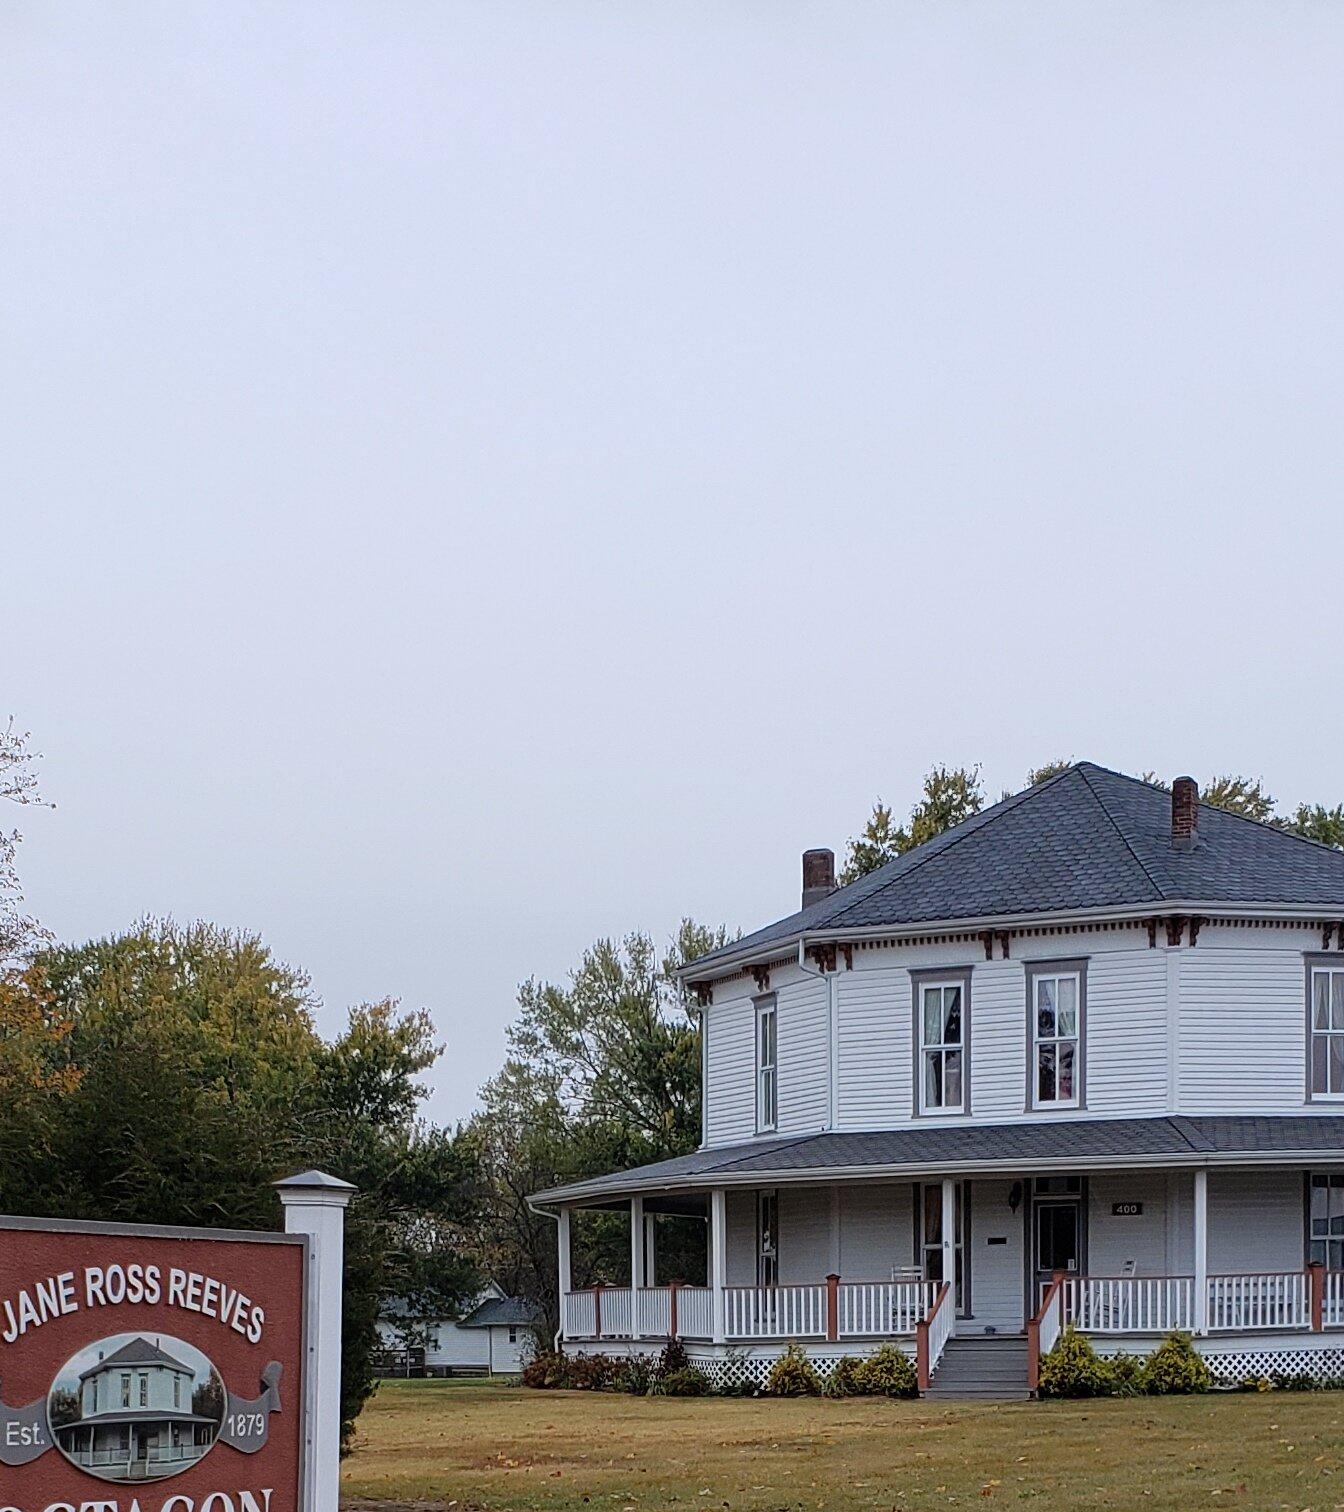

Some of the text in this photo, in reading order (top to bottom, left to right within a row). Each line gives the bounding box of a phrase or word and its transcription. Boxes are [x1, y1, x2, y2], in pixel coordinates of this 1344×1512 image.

[1116, 1204, 1137, 1214] 400
[2, 1264, 265, 1344] JANE ROSS REEVES
[6, 1420, 46, 1447] Est.
[228, 1412, 265, 1438] 1879
